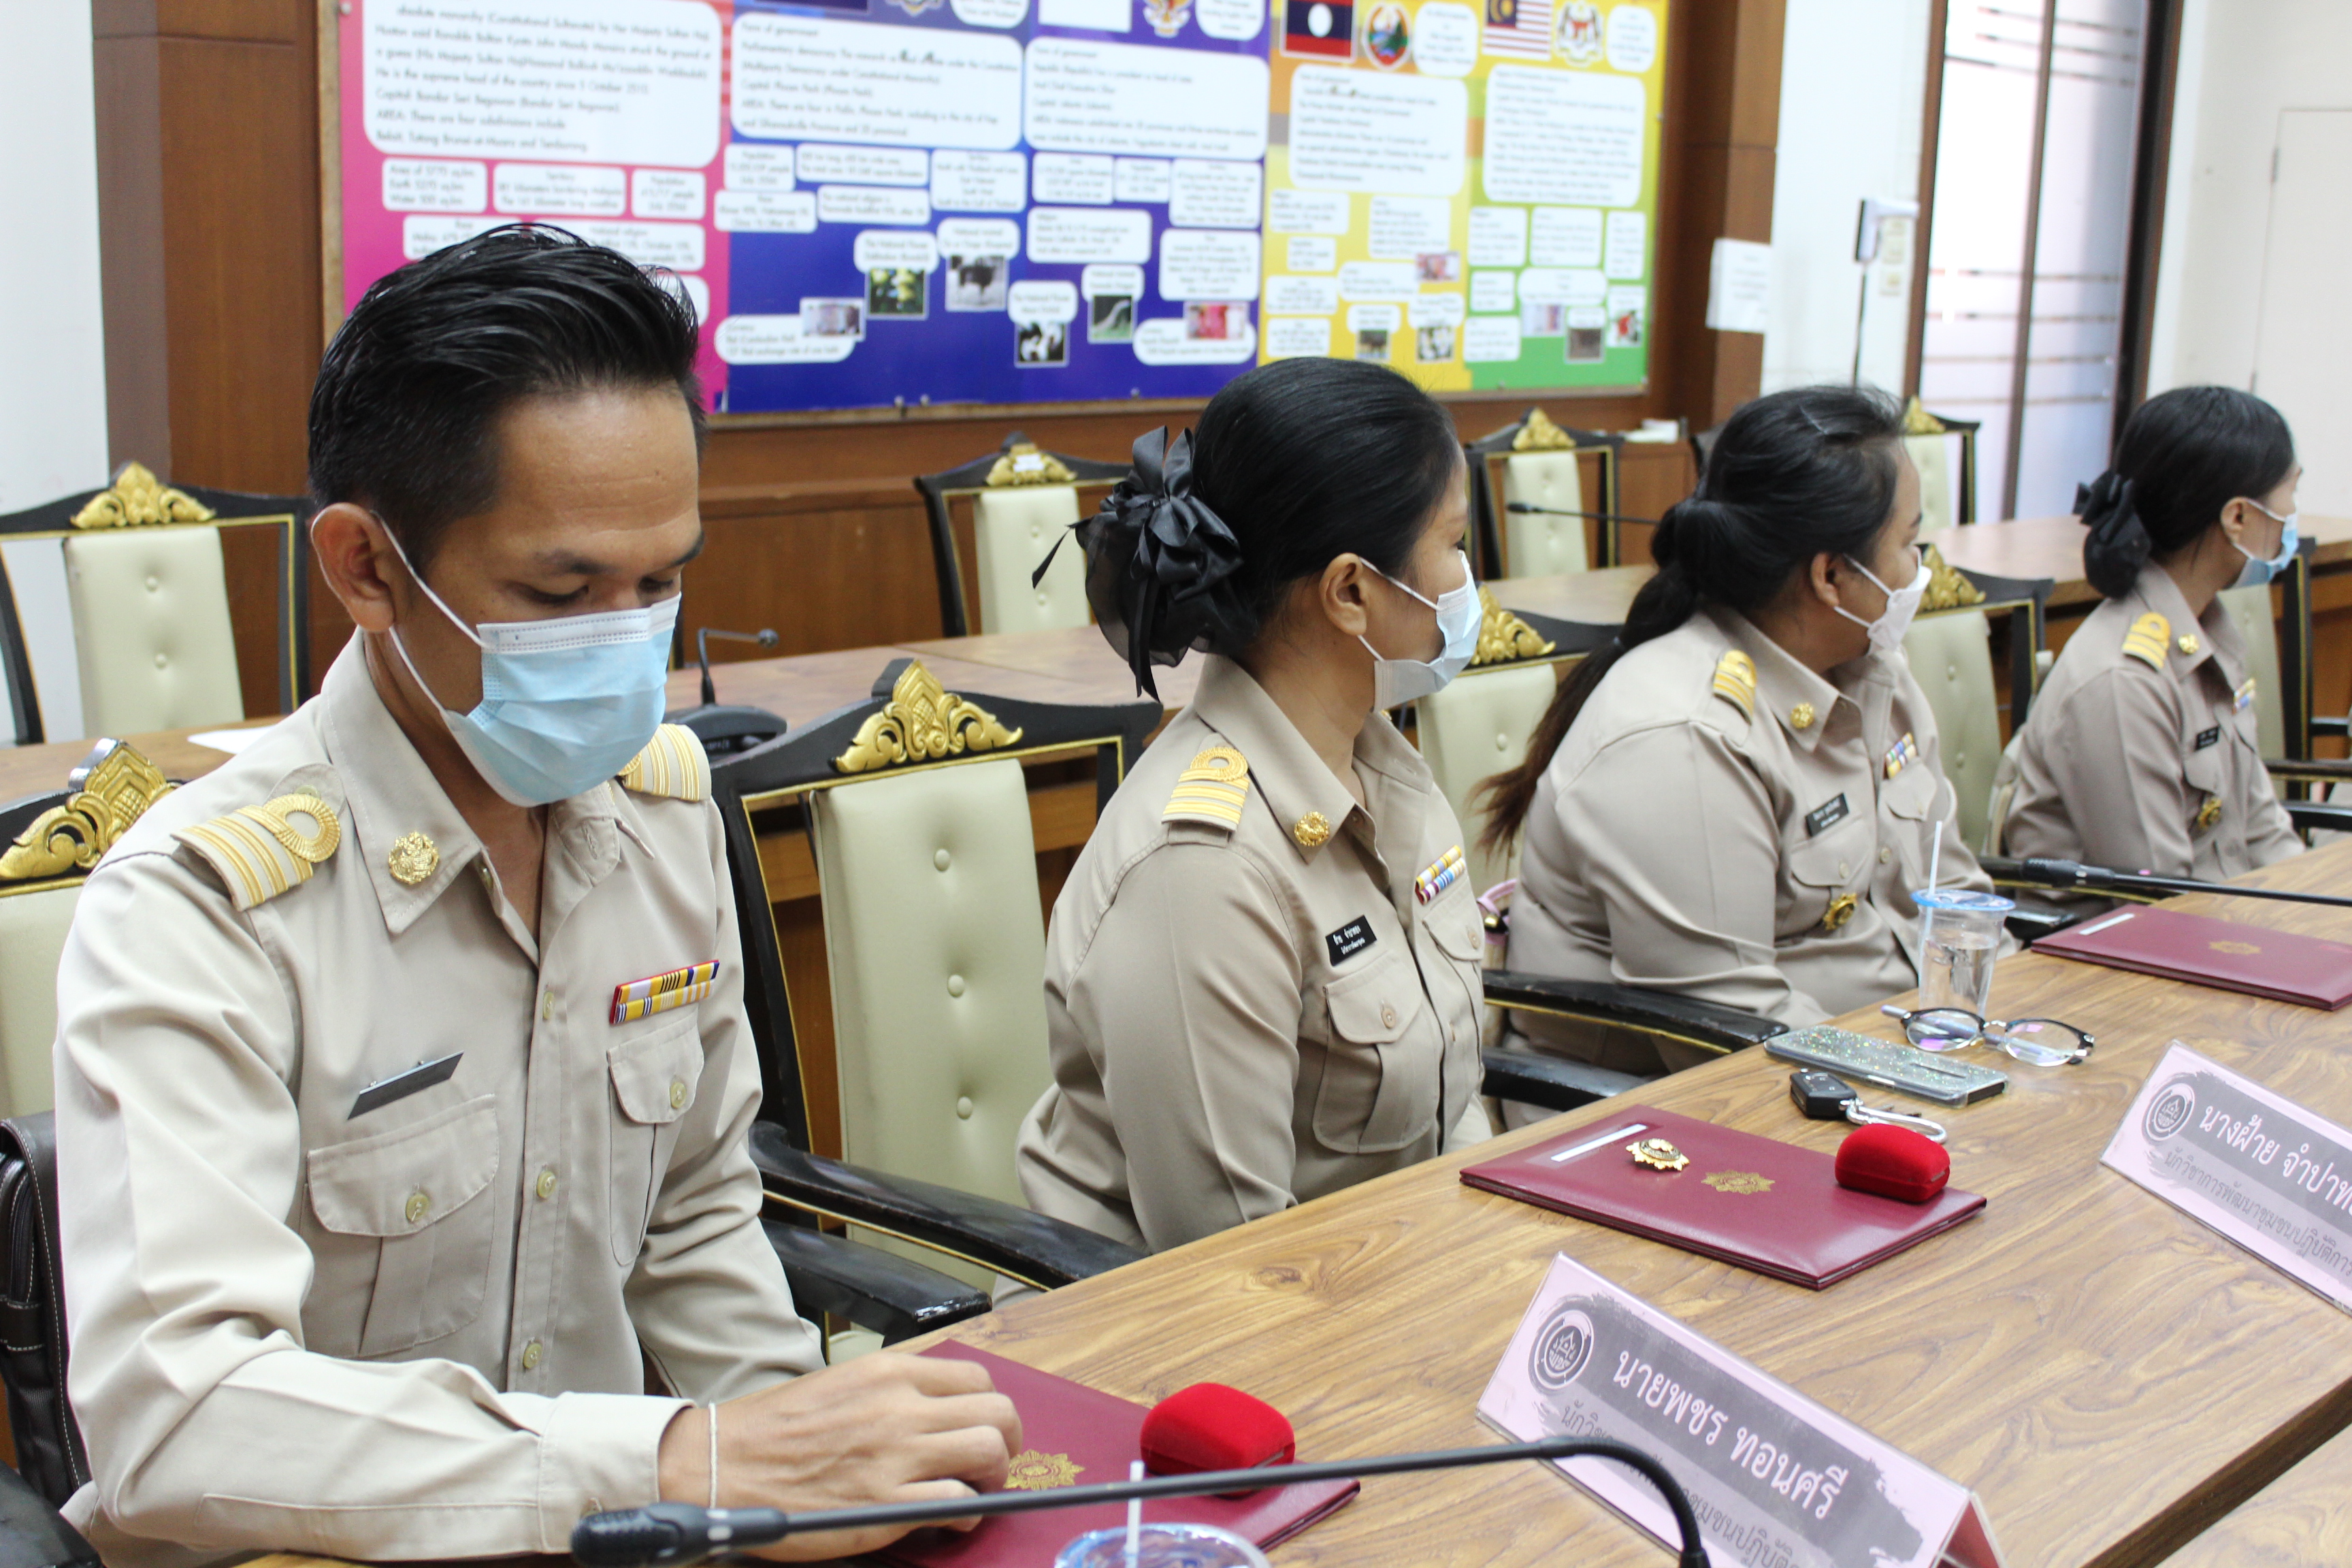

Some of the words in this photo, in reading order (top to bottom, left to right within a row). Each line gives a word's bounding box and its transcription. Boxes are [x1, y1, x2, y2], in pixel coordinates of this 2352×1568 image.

[2199, 1105, 2280, 1165] นางฝ้าย
[2282, 1143, 2352, 1216] จำปาท
[1613, 1348, 1729, 1442] นายพชร
[1731, 1426, 1848, 1520] ทอนศรี
